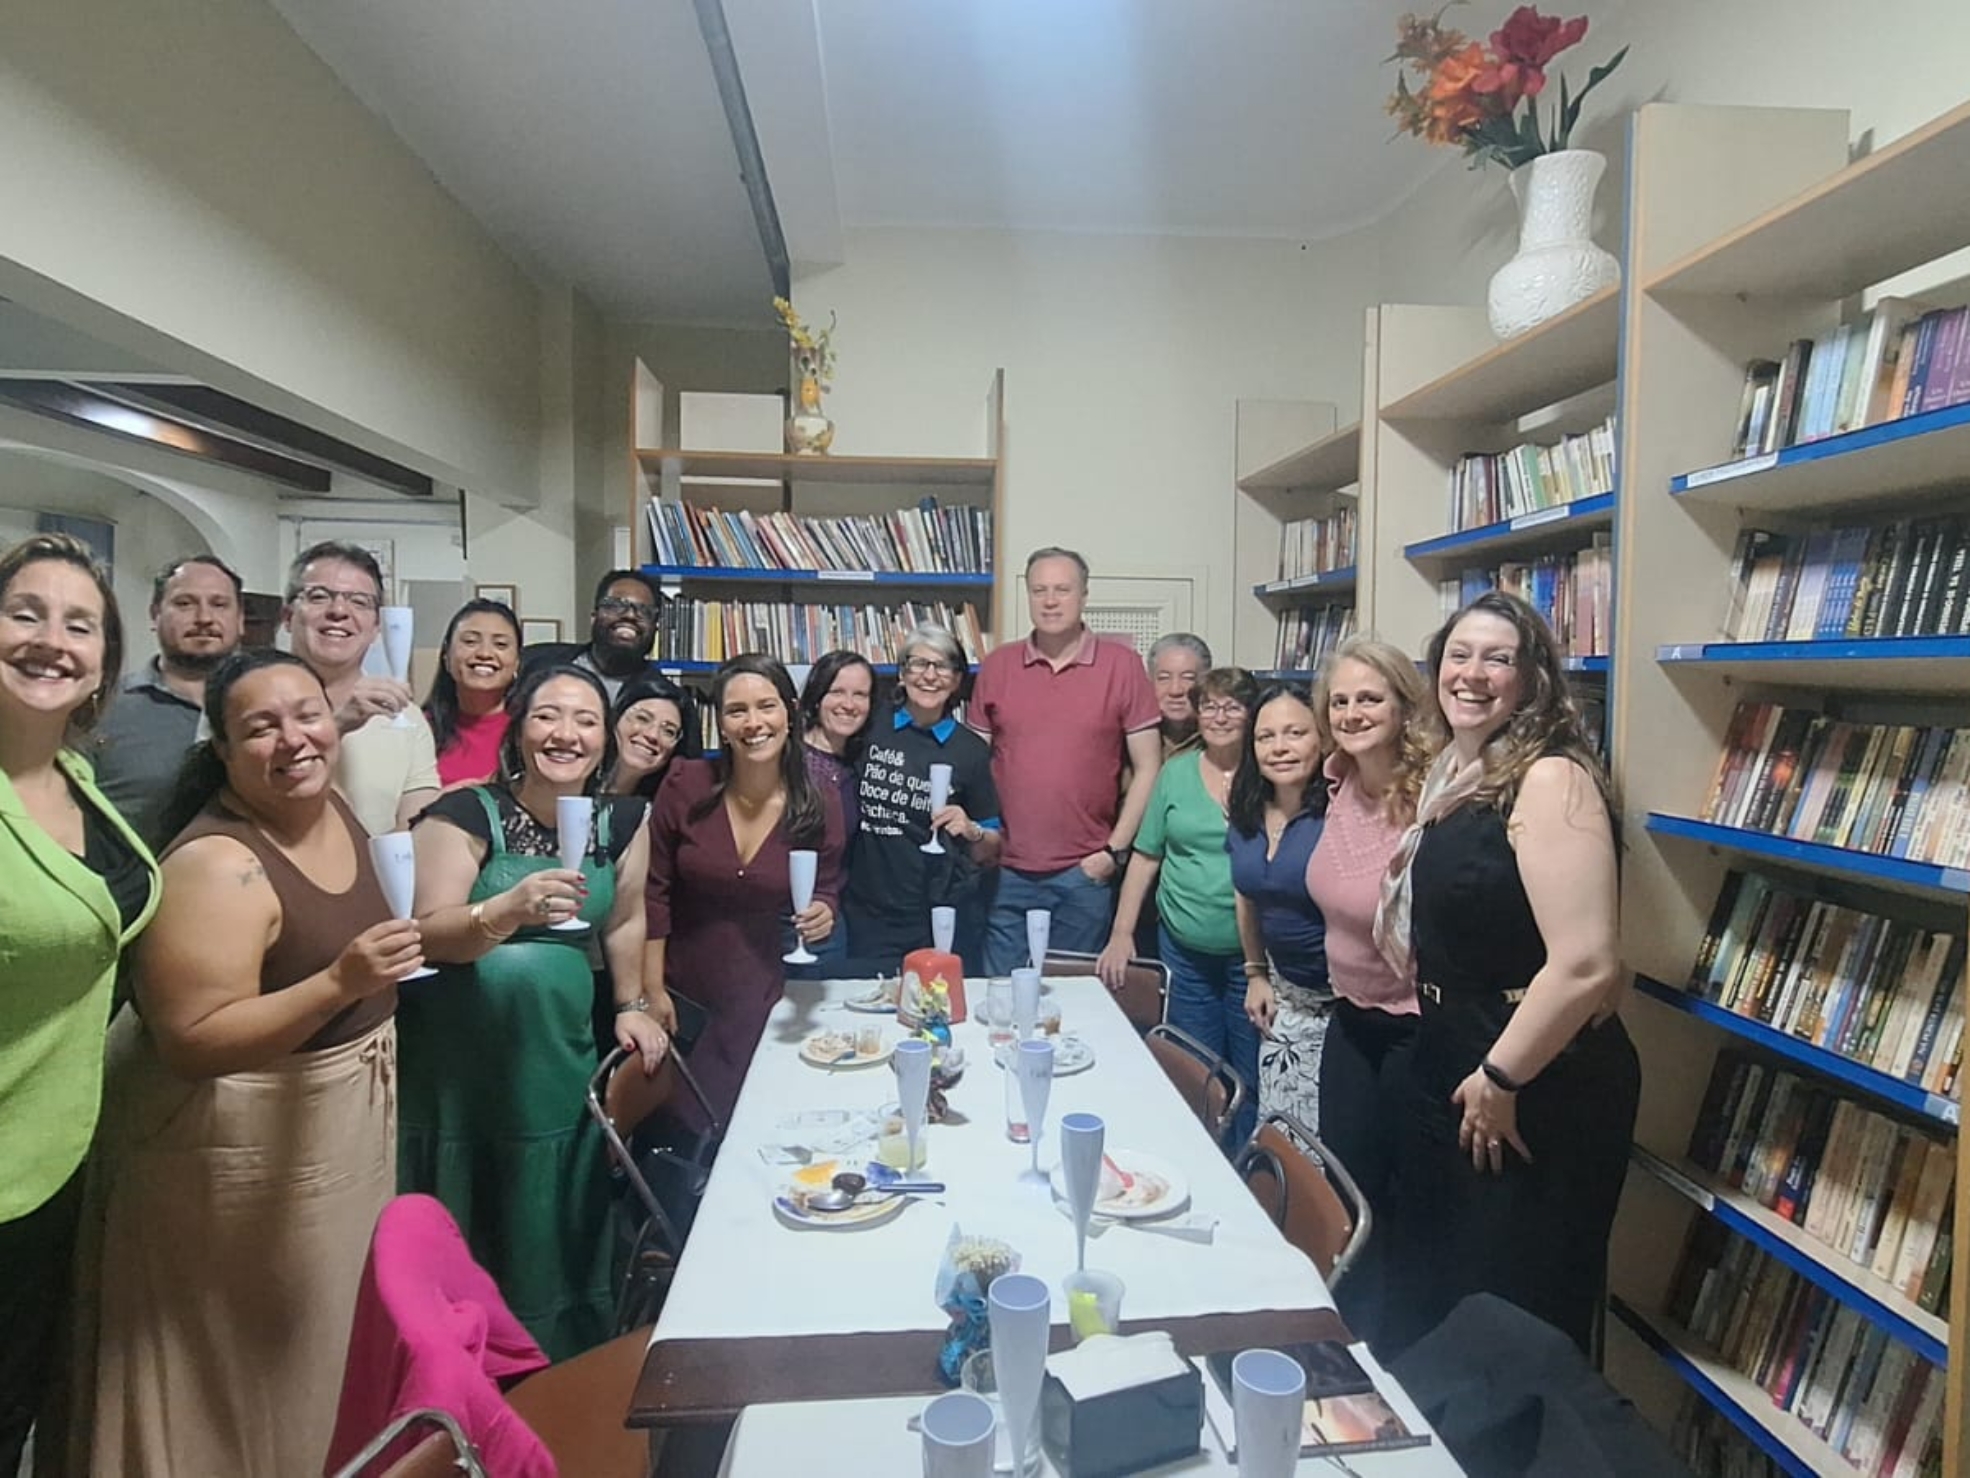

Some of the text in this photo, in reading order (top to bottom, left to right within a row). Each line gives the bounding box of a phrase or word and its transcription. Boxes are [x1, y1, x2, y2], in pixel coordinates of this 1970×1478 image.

[864, 763, 887, 781] Pão
[888, 770, 905, 786] de
[859, 781, 889, 801] Doce
[891, 790, 909, 806] de
